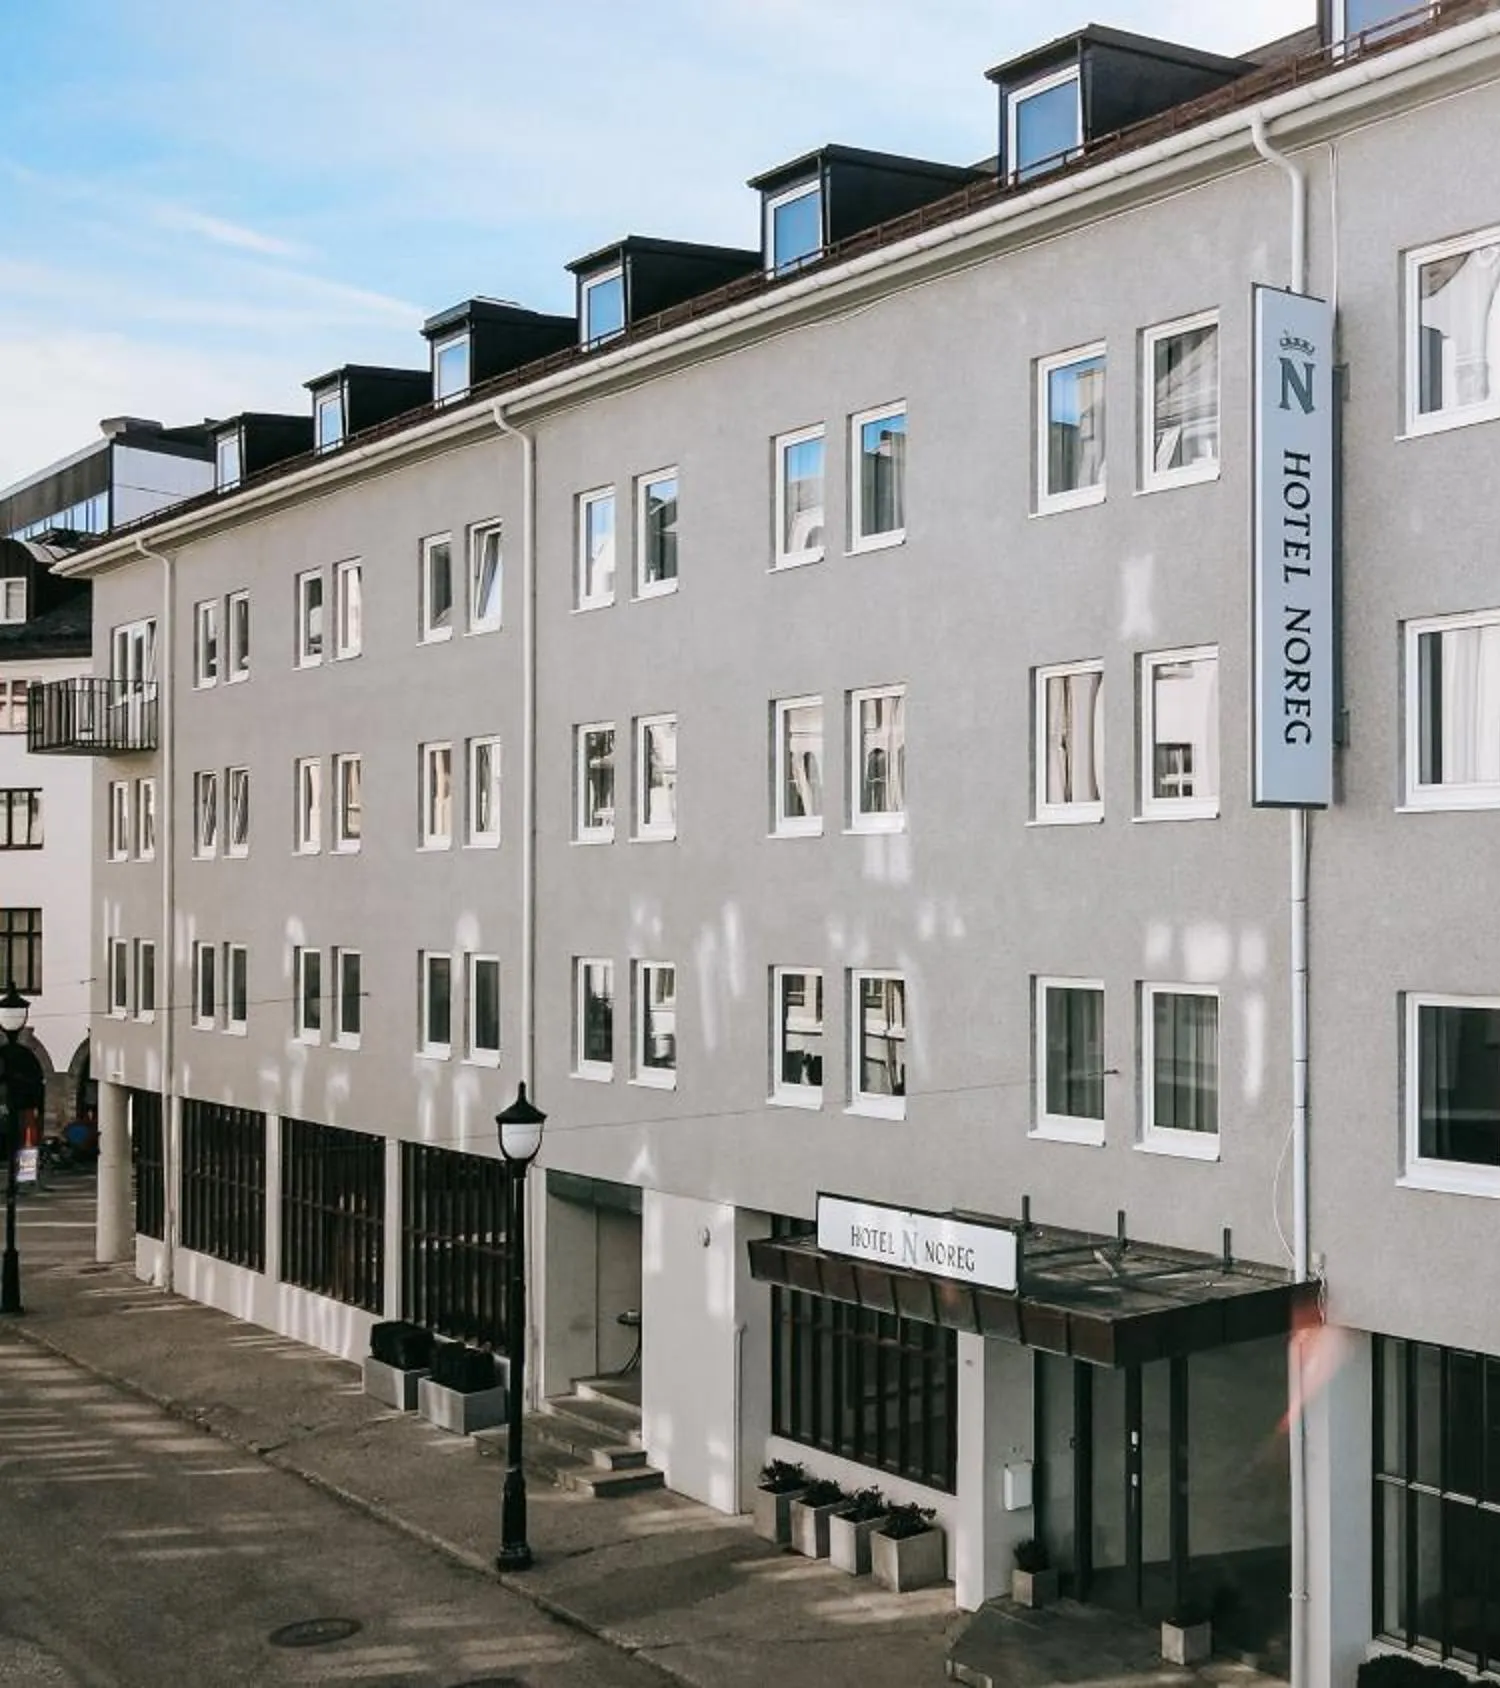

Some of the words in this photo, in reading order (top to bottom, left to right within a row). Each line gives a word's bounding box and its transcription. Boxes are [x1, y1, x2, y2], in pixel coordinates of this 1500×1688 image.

[1279, 356, 1316, 415] N
[1282, 449, 1312, 585] HOTEL
[1284, 605, 1312, 746] NOREG
[850, 1224, 895, 1255] HOTEL
[901, 1229, 919, 1265] N
[924, 1239, 976, 1272] NOREG
